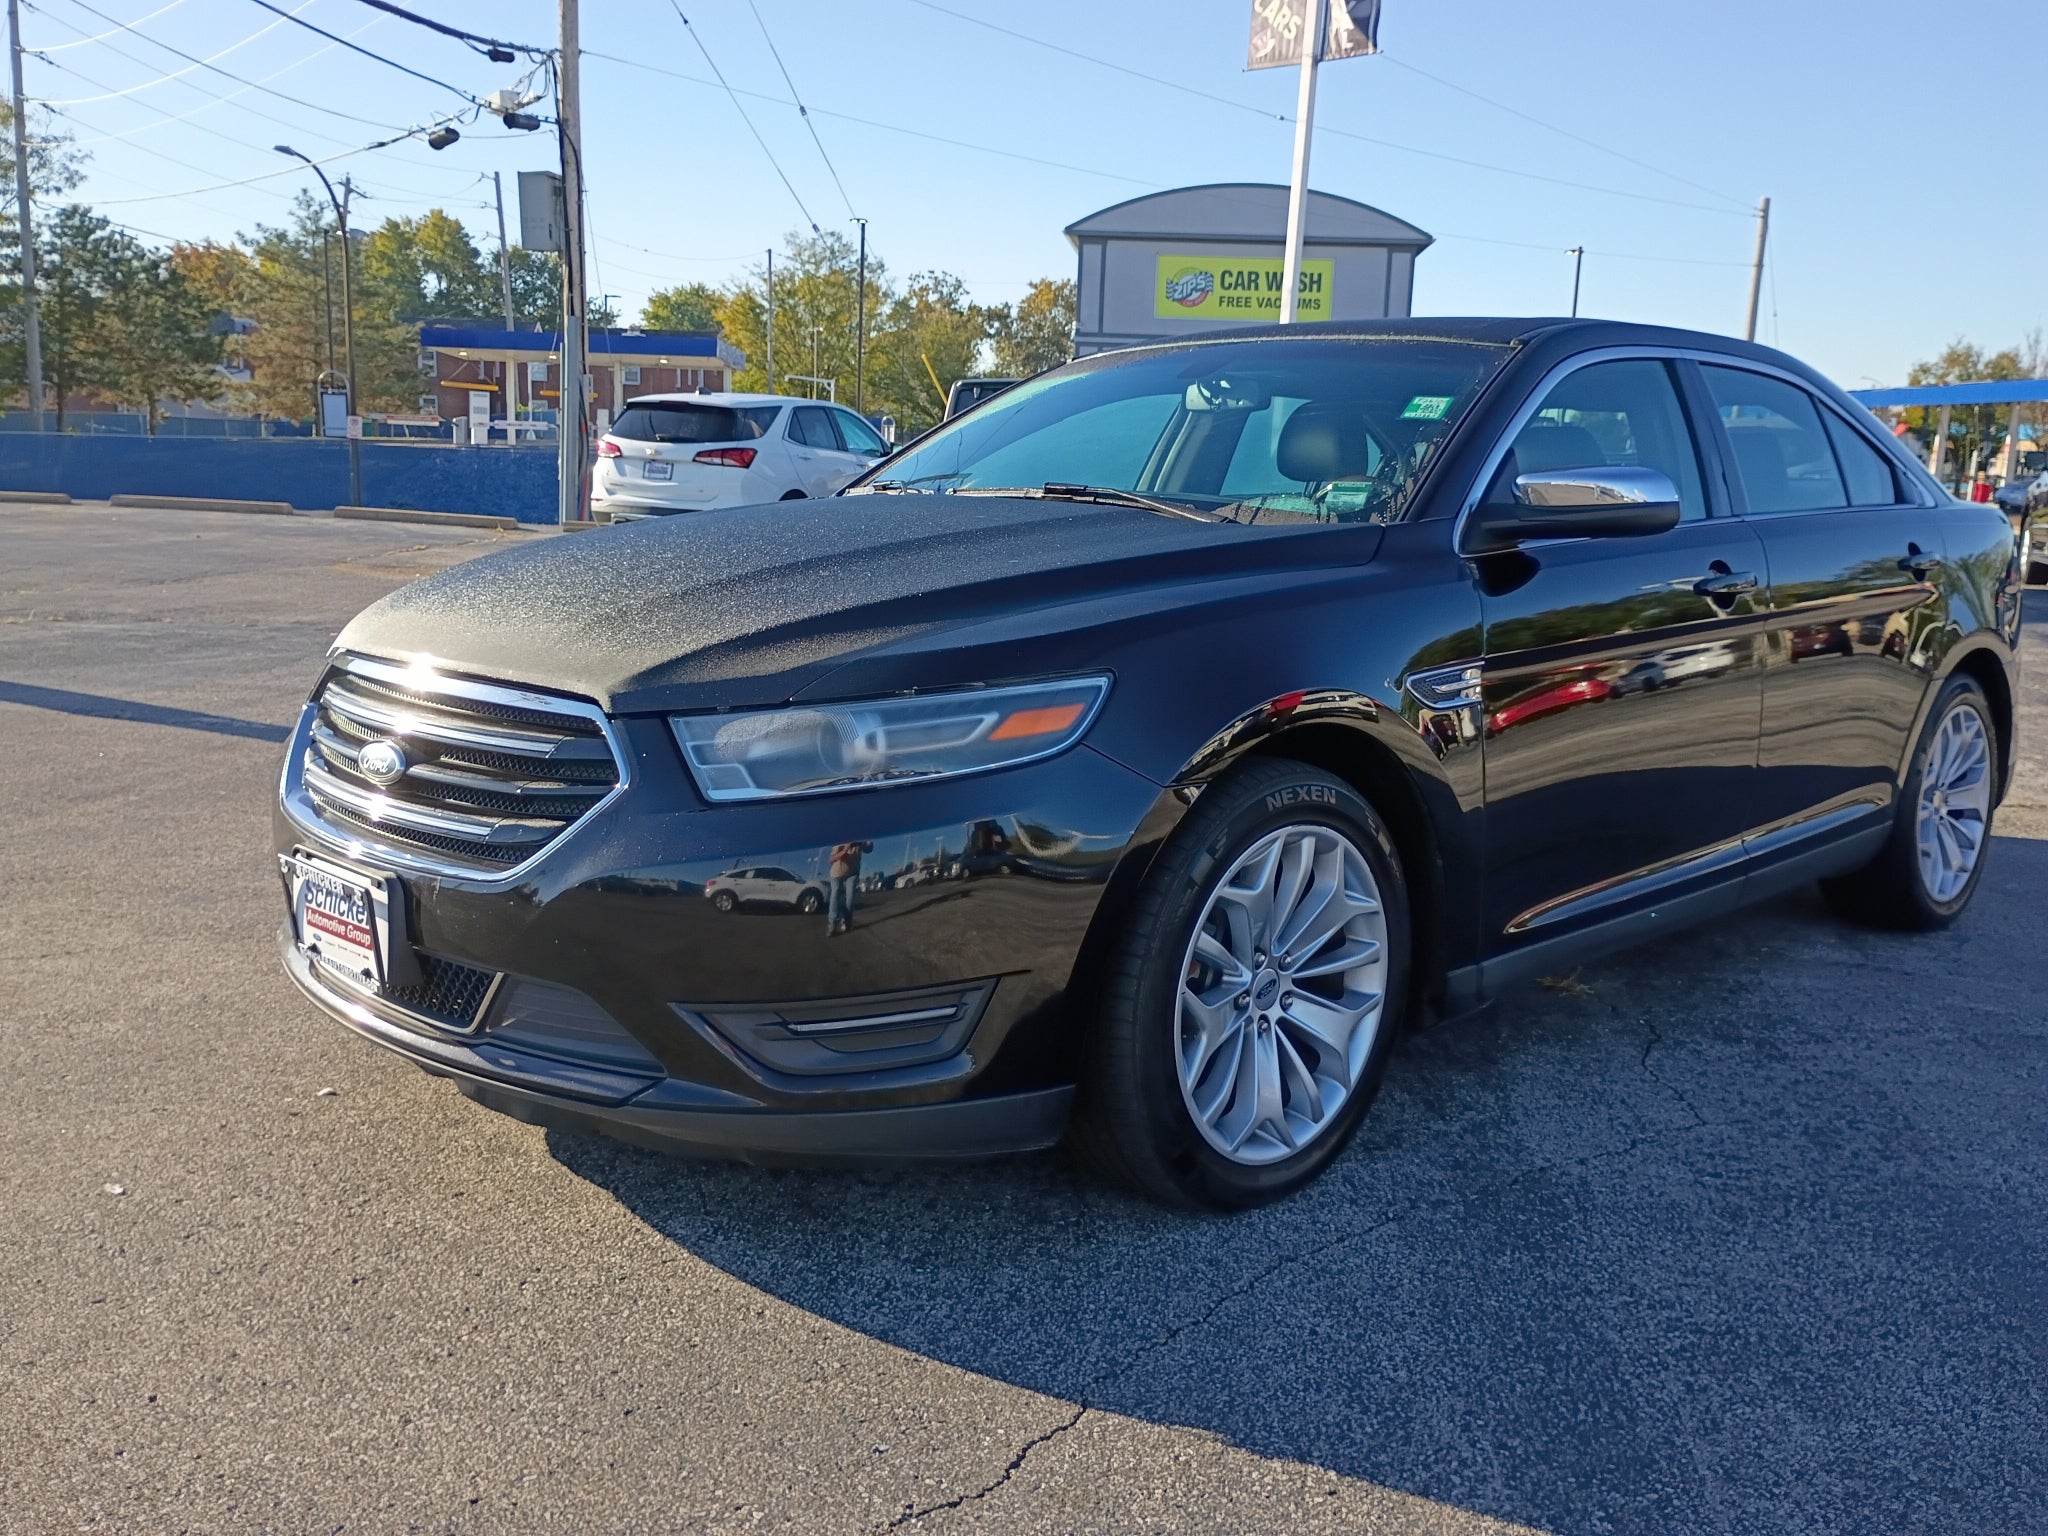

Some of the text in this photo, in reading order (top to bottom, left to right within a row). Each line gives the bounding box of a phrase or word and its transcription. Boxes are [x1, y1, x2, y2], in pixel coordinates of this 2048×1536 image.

[1173, 275, 1206, 300] ZIPS
[1220, 270, 1322, 293] CAR WSH
[1218, 296, 1252, 308] FREE
[1256, 297, 1321, 310] VACMS
[1266, 785, 1337, 812] NEXEN
[307, 909, 371, 946] Automotive Group
